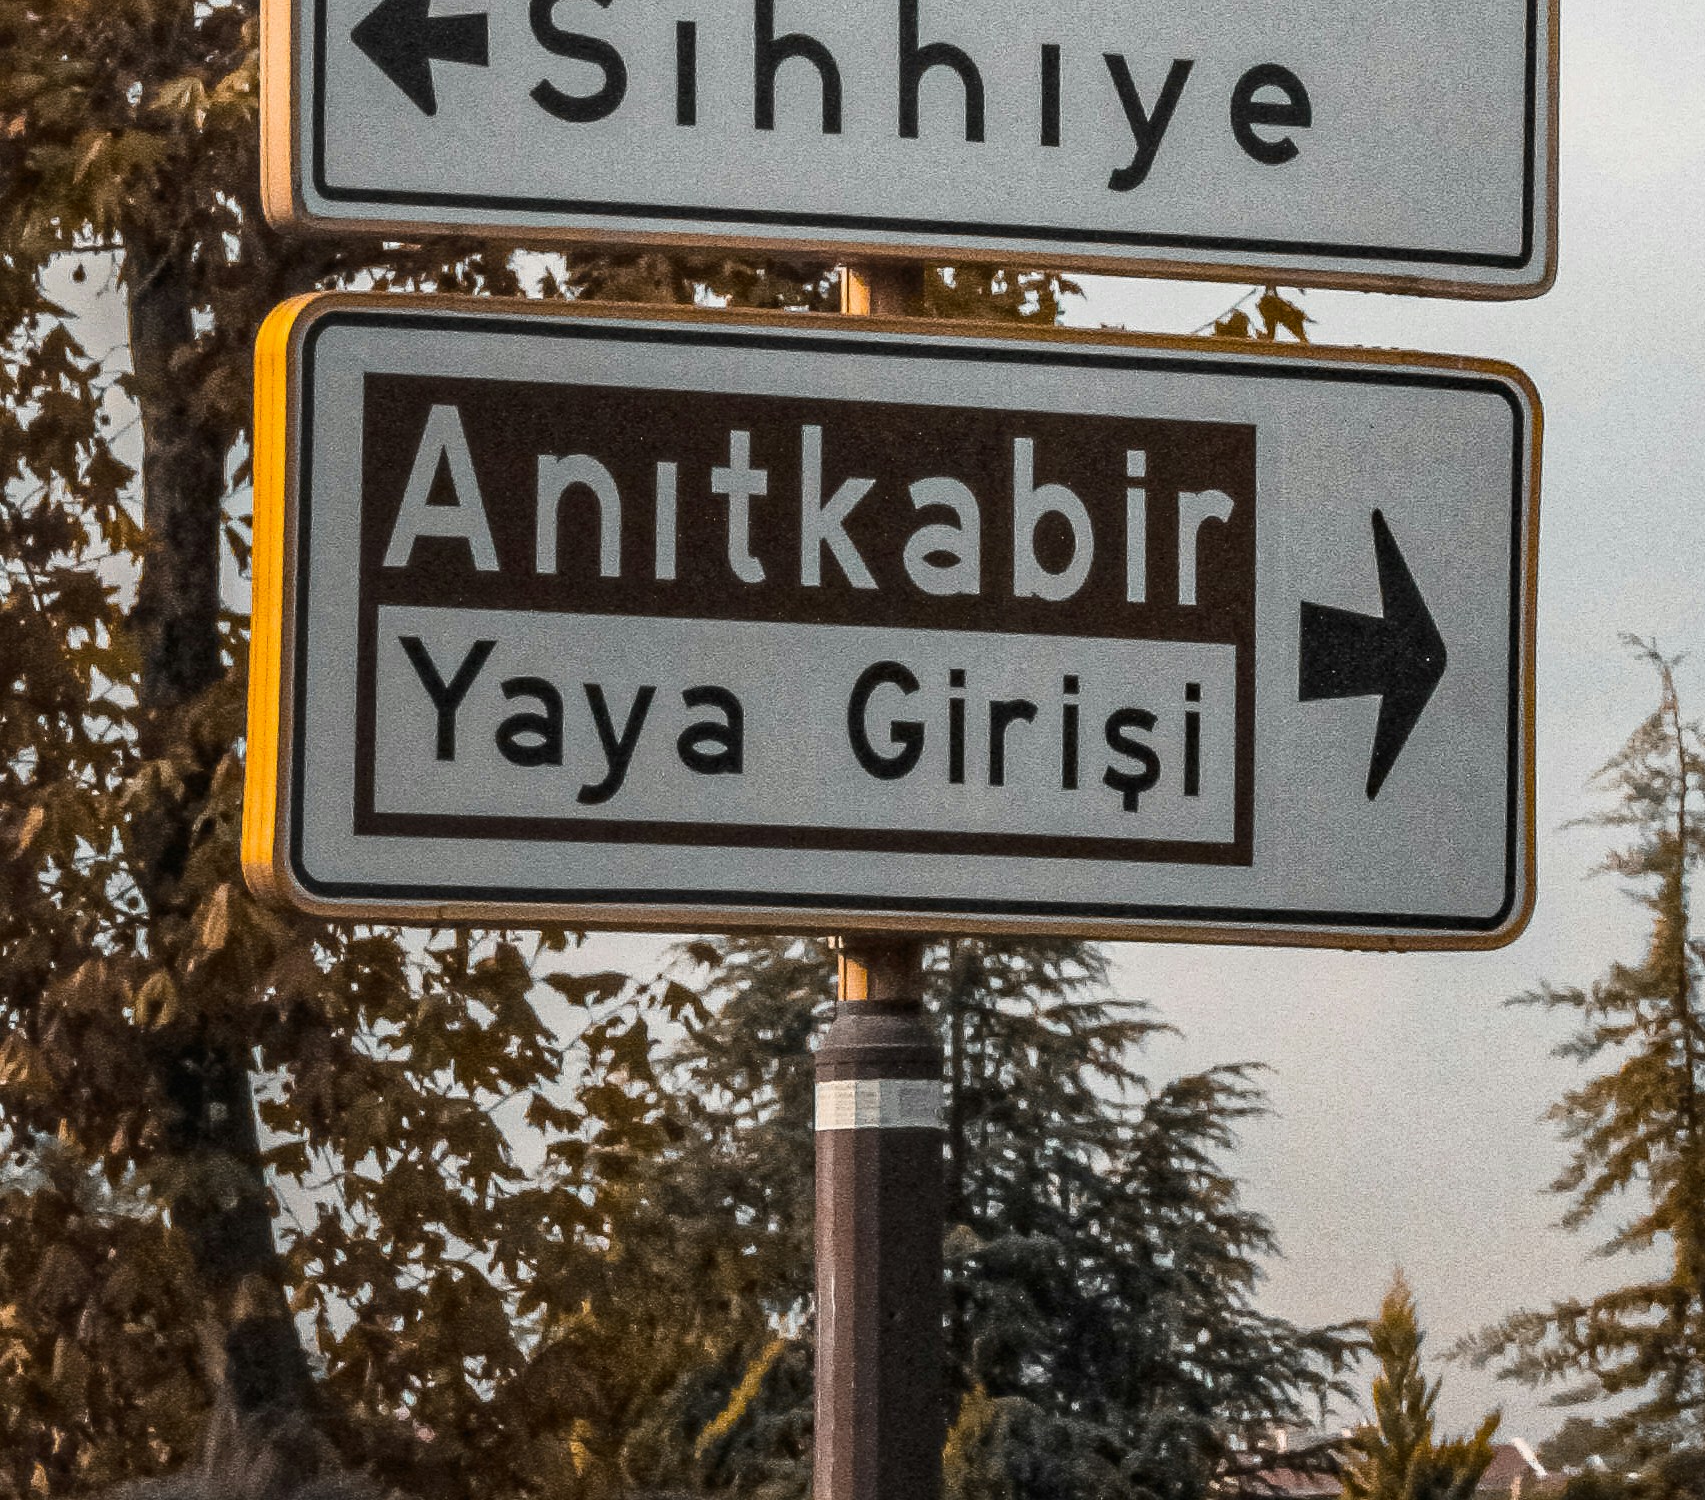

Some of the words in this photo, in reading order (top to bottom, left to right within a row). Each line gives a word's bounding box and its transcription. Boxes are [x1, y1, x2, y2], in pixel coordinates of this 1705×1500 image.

[383, 404, 1235, 609] Anıtkabir
[399, 637, 746, 805] Yaya
[847, 660, 1203, 812] Girişi
